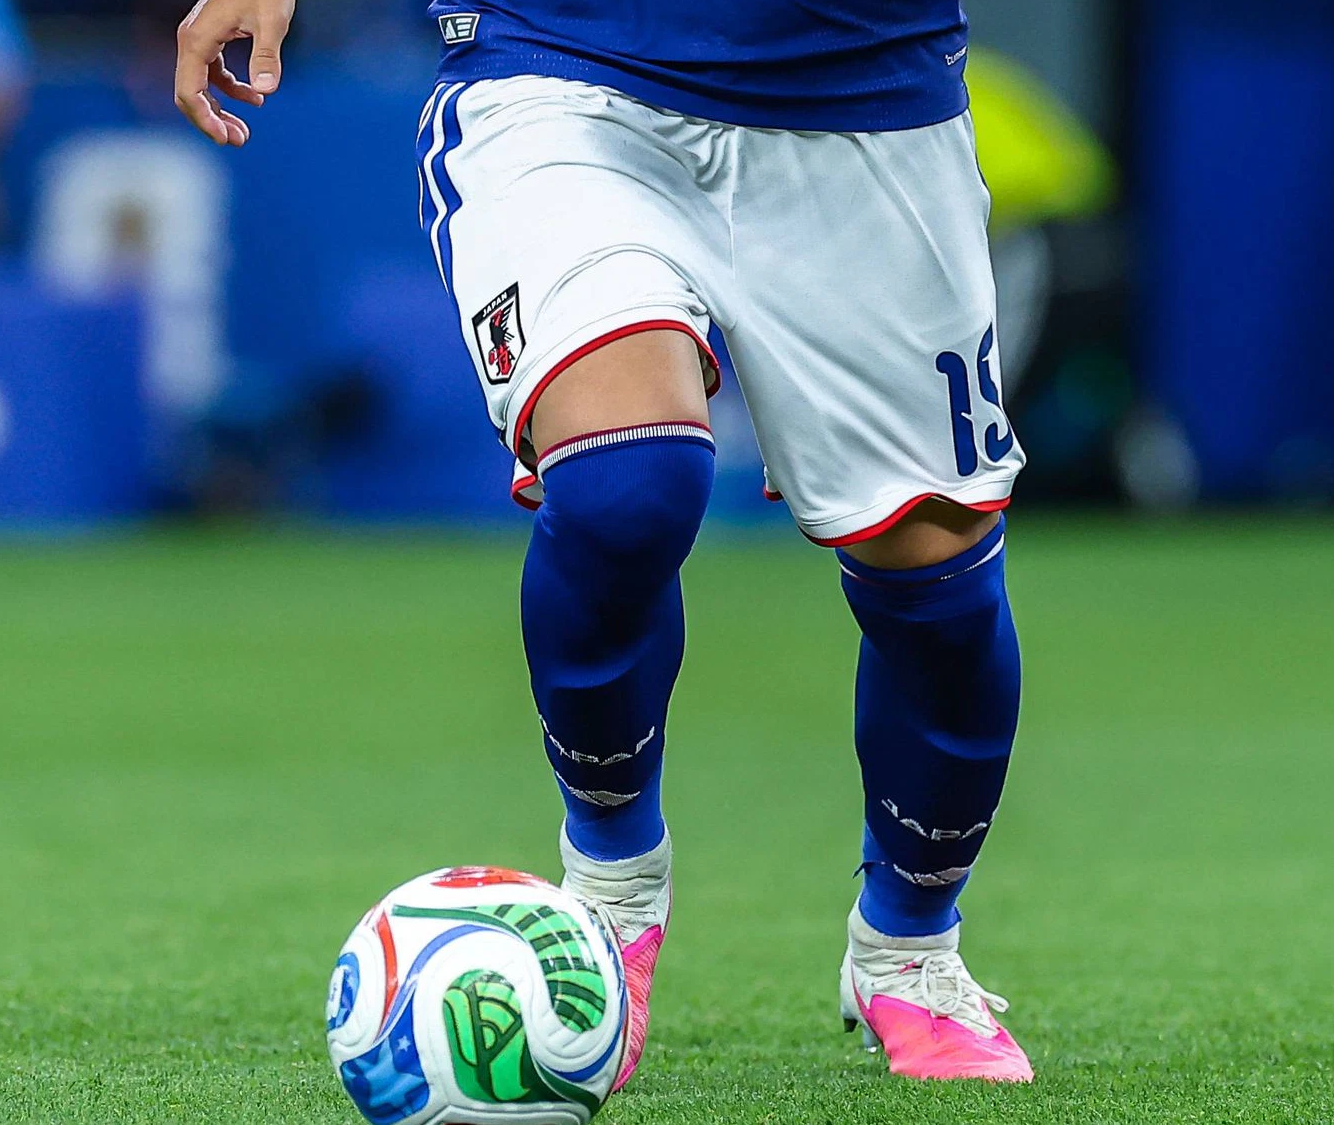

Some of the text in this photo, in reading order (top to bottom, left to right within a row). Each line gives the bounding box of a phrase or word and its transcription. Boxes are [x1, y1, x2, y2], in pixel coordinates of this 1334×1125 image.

[482, 291, 508, 318] JAPAN
[935, 320, 1014, 477] 15
[881, 798, 993, 841] JAPA
